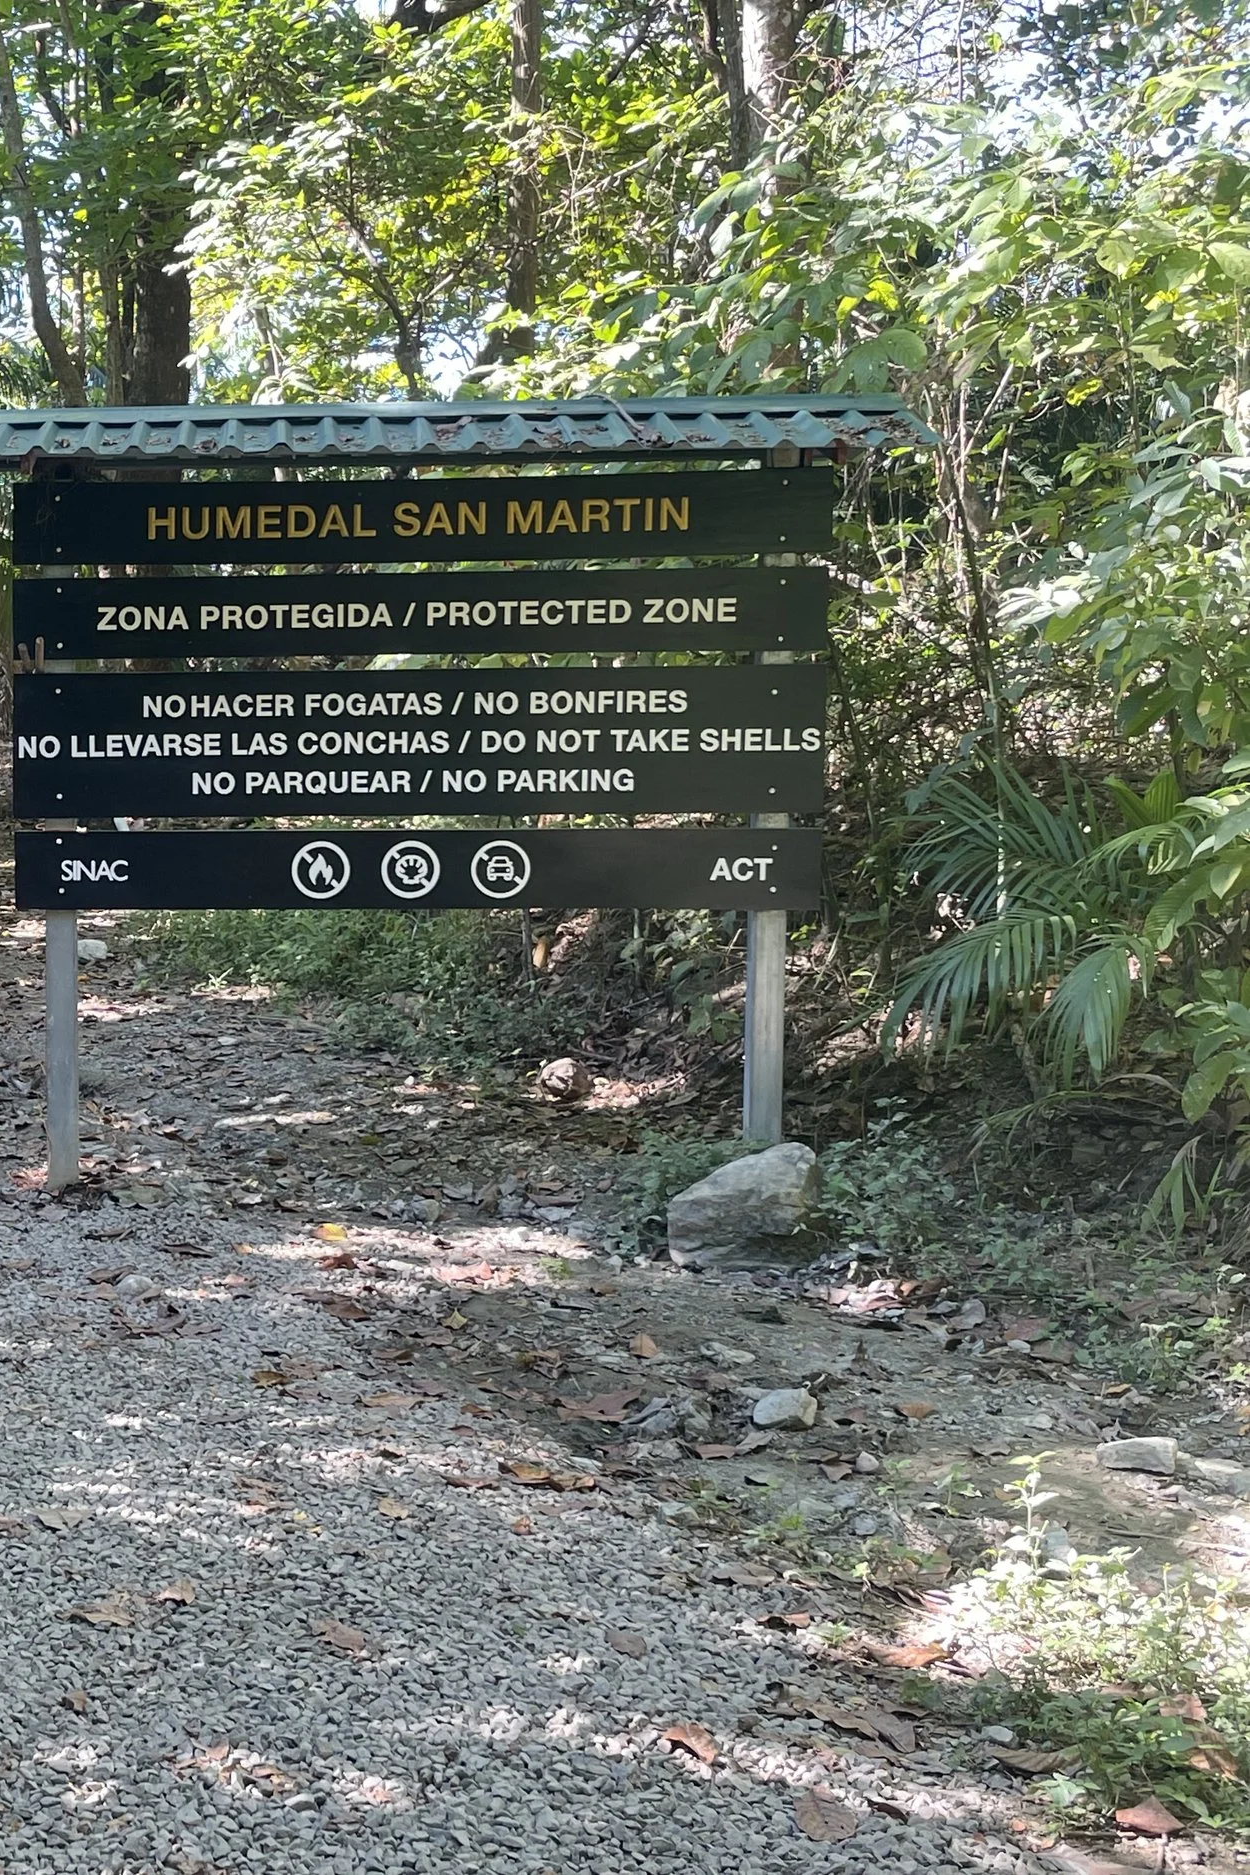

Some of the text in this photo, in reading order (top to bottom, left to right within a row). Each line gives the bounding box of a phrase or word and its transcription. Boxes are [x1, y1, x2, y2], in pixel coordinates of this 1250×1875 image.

[147, 497, 691, 541] HUMEDAL SAN MARTIN
[97, 597, 738, 632] ZONA PROTEGIDA / PROTECTED ZONE
[305, 692, 443, 717] FOGATAS
[451, 691, 465, 716] /
[475, 691, 519, 715] NO
[529, 689, 688, 715] BONFIRES
[18, 727, 821, 759] NO LLEVARSE LAS CONCHAS / DO NOT TAKE SHELLS
[191, 768, 635, 796] NO PARQUEAR / NO PARKING
[60, 859, 129, 882] SINAC
[709, 857, 774, 882] ACT
